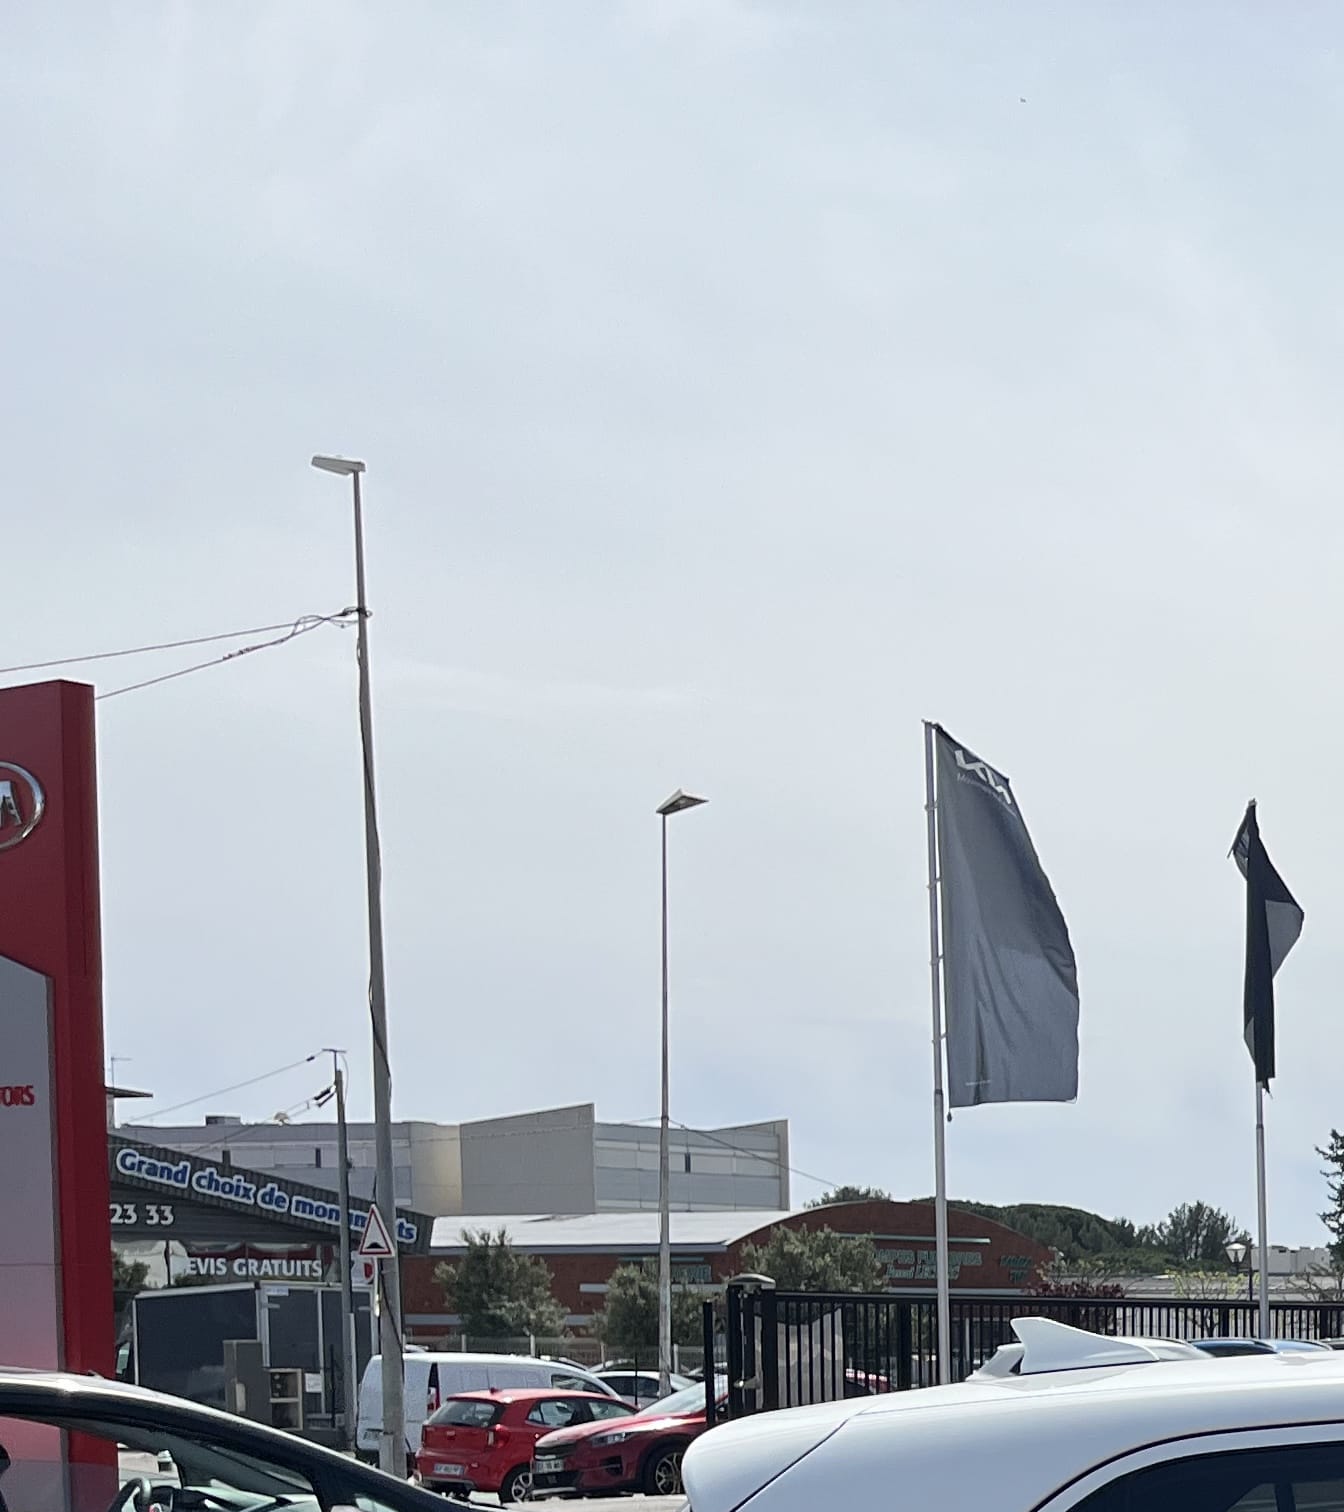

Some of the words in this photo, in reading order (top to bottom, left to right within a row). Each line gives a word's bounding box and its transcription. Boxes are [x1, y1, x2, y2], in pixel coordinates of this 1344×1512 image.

[116, 1149, 189, 1188] Grand
[192, 1168, 257, 1205] choix
[258, 1184, 289, 1213] de
[291, 1196, 418, 1244] monmts
[110, 1204, 138, 1225] 23
[146, 1205, 174, 1226] 33
[186, 1257, 227, 1276] EVIS
[232, 1258, 323, 1278] GRATUITS
